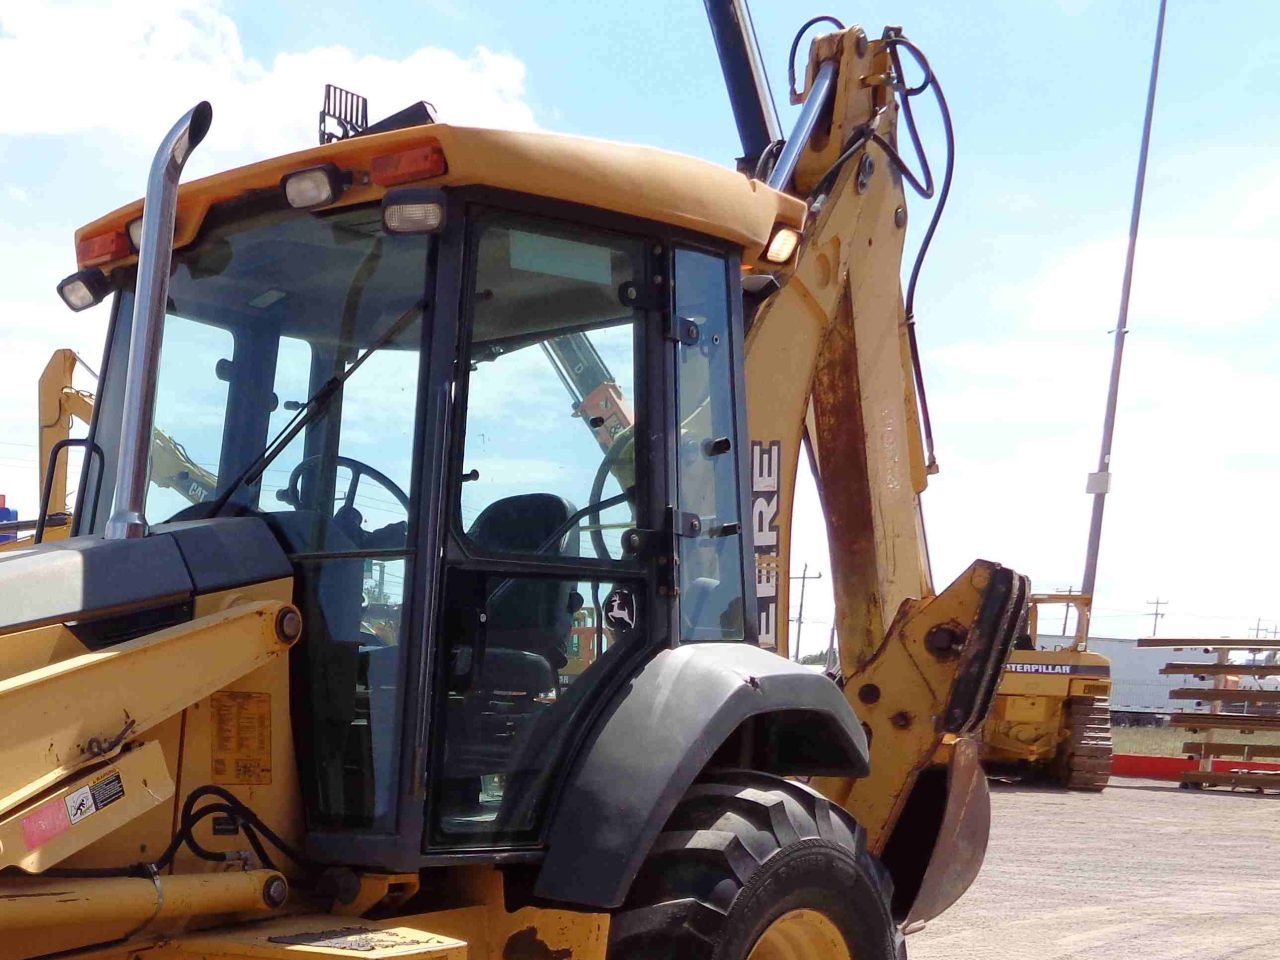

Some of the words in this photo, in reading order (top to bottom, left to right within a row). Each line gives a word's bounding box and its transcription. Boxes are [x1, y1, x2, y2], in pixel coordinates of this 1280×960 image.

[188, 482, 208, 503] CAT
[751, 442, 780, 650] EERE
[1004, 663, 1071, 674] ATERPILLAR
